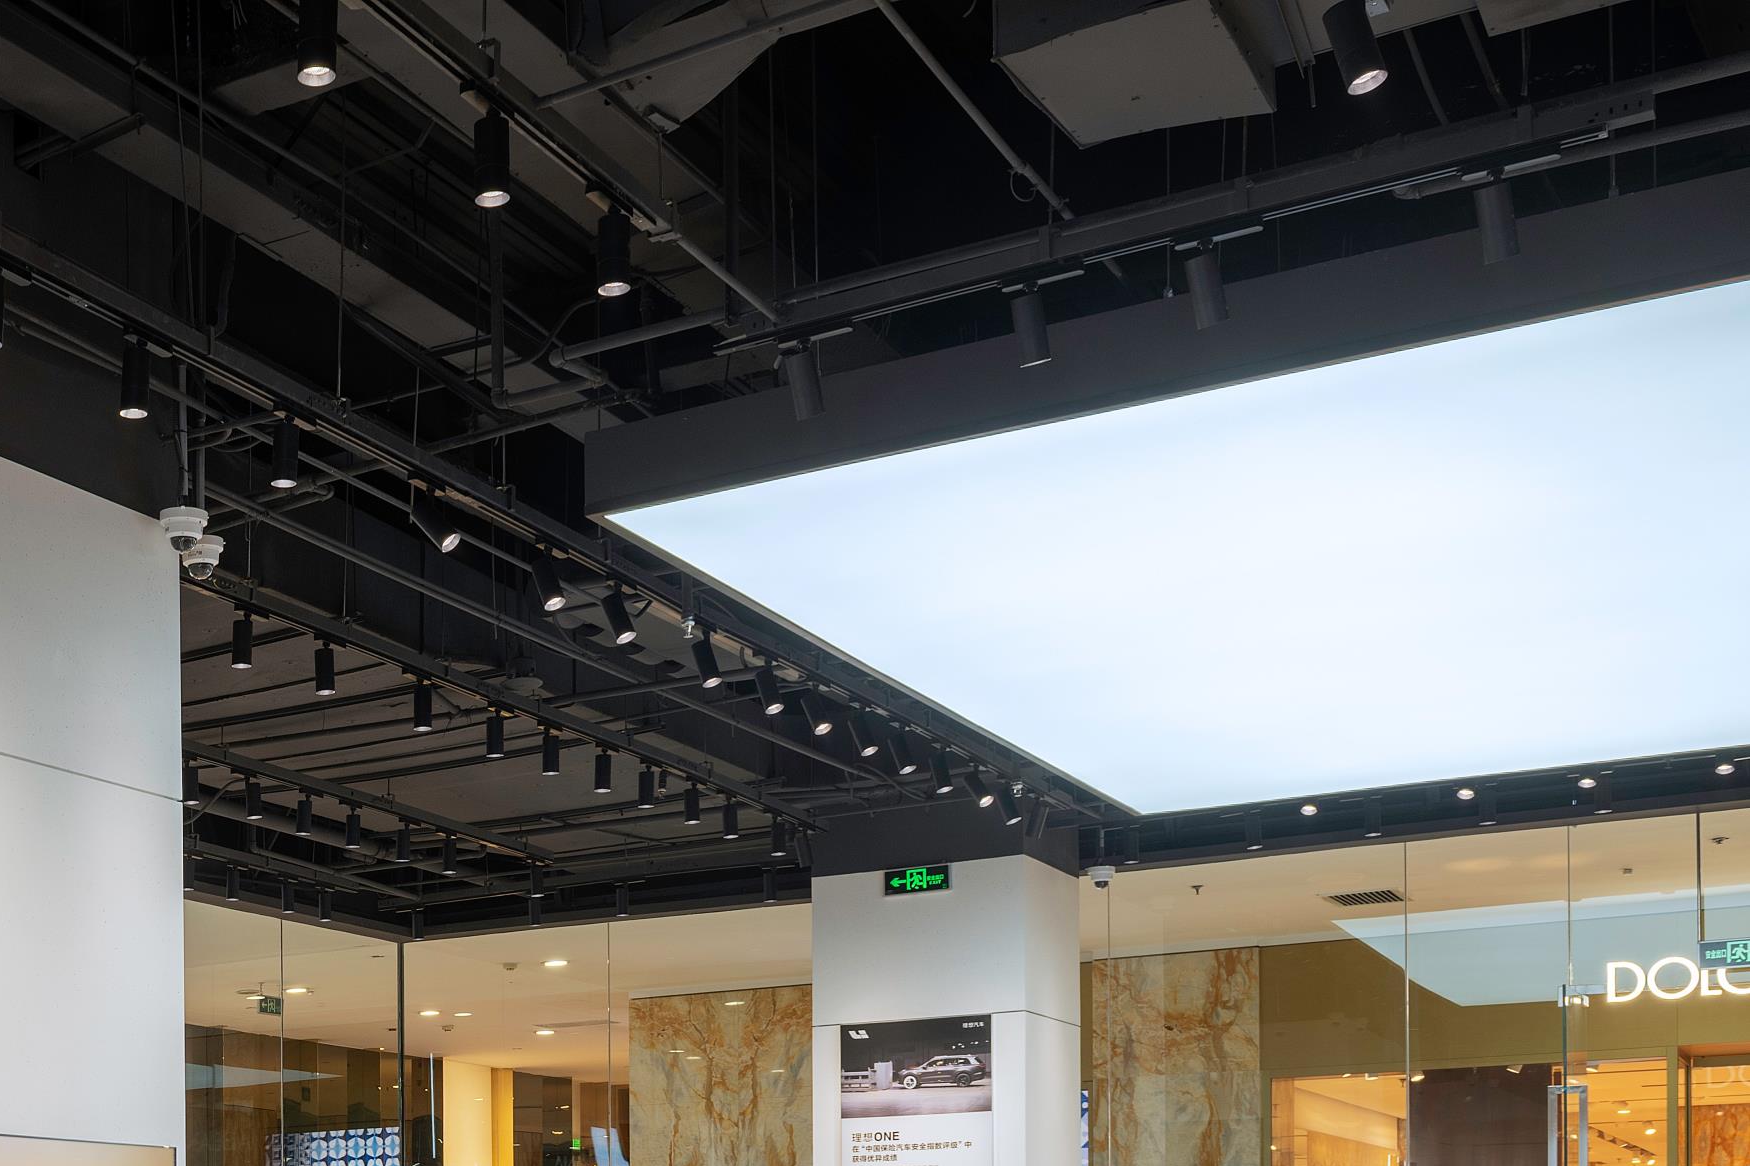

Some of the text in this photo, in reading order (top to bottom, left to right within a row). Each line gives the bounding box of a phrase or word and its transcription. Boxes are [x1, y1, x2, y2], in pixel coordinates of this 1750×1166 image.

[1705, 949, 1727, 960] 安全出口
[852, 1131, 900, 1142] 理想ONE
